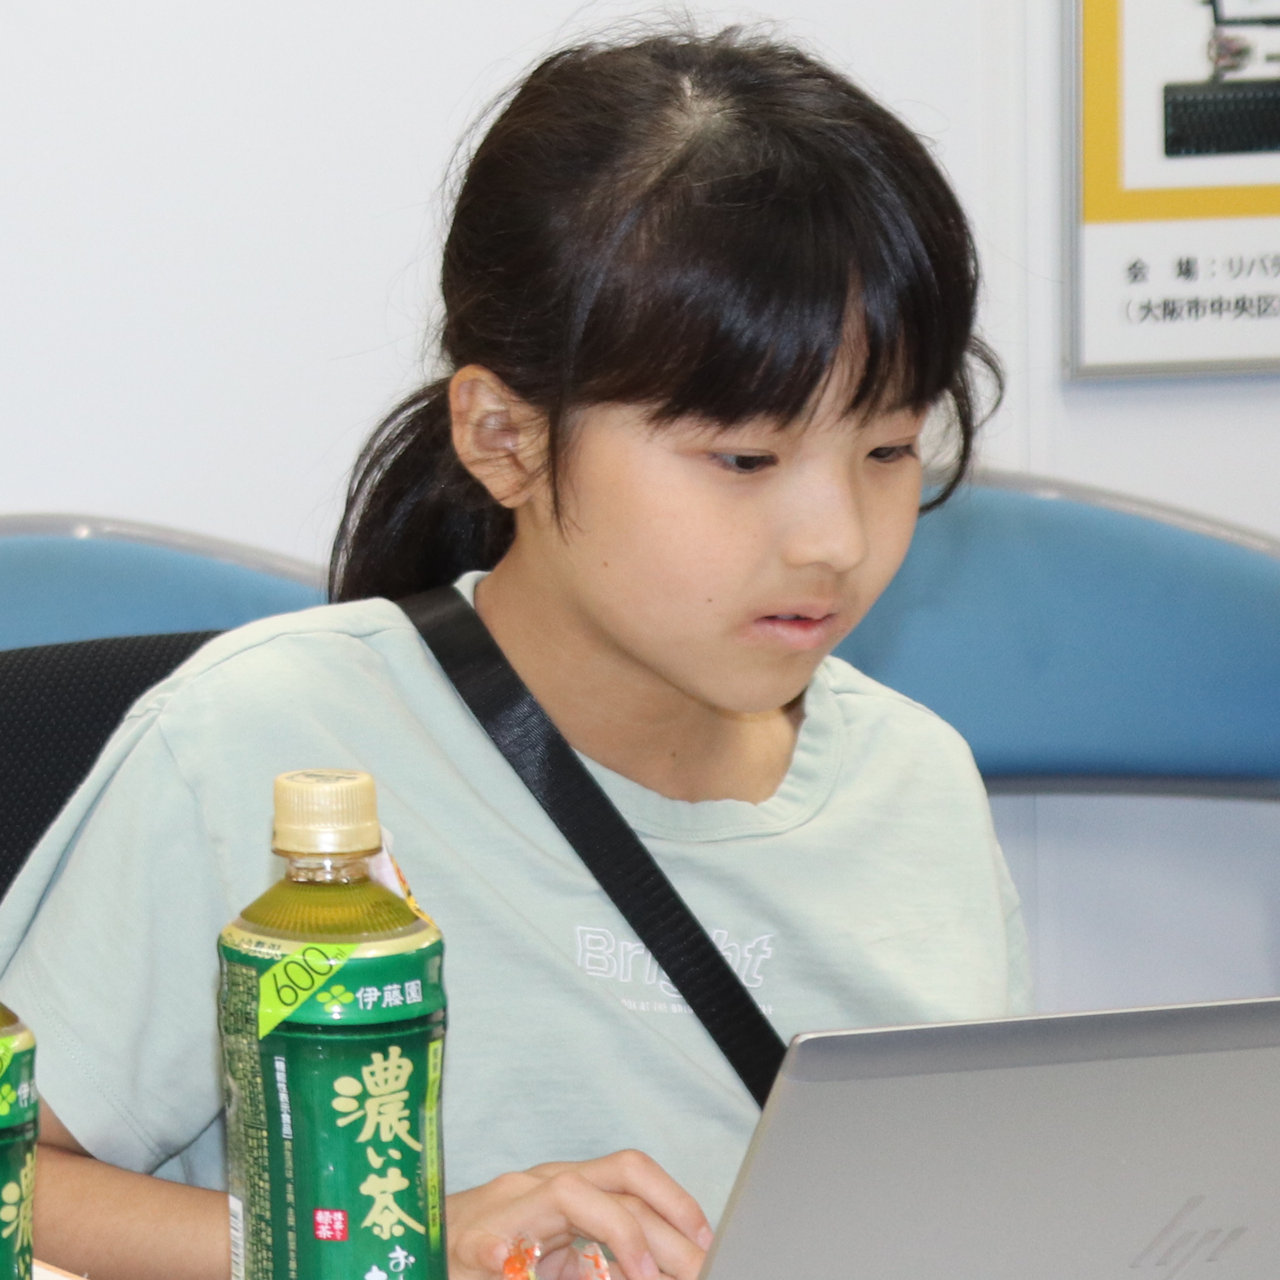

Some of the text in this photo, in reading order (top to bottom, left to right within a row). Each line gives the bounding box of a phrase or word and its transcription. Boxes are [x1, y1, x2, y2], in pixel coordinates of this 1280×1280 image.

[356, 979, 423, 1010] 伊藤園
[577, 926, 774, 998] Briht
[332, 1046, 426, 1240] 濃い茶
